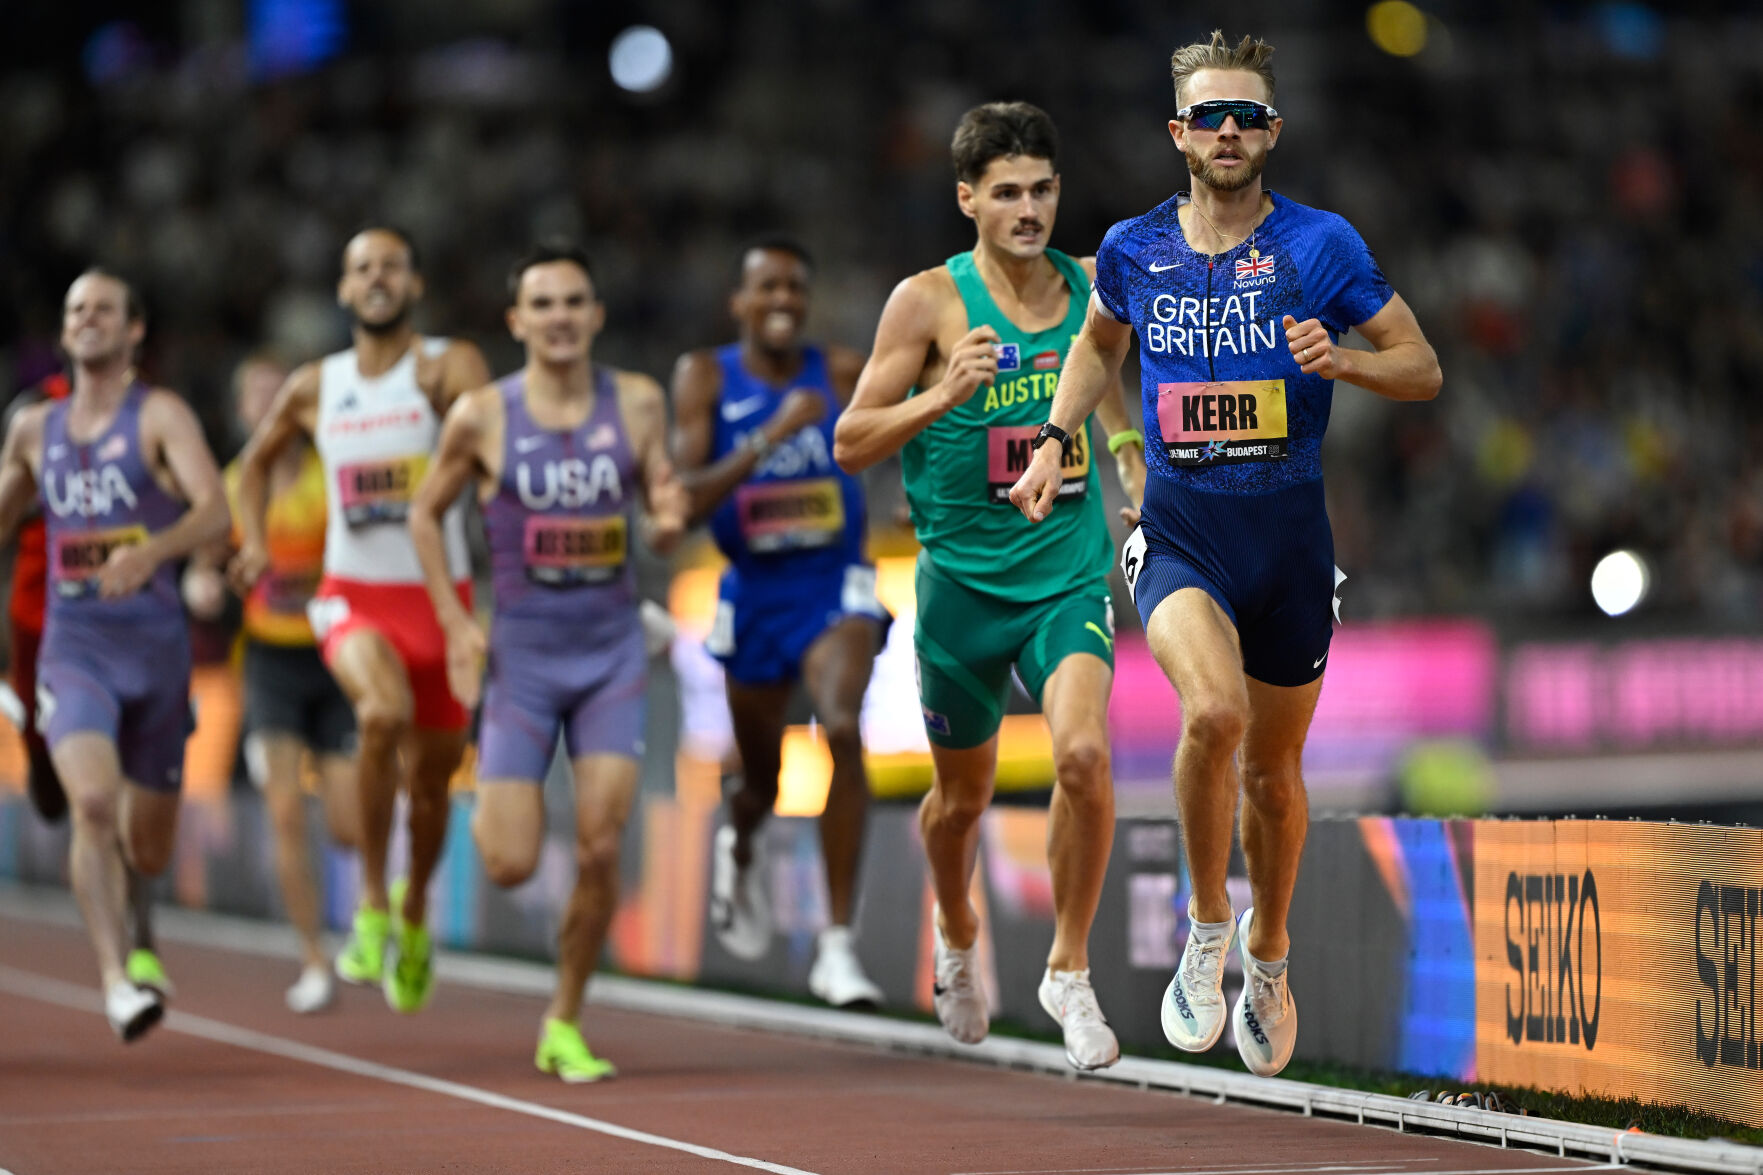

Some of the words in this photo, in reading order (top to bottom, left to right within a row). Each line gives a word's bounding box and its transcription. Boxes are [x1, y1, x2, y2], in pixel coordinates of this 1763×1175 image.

[1233, 275, 1276, 290] Novuna
[1153, 291, 1262, 327] GREAT
[1148, 319, 1276, 358] BRITAIN
[984, 373, 1058, 413] AUSTR
[1182, 394, 1258, 432] KERR
[1007, 433, 1085, 473] MRS
[1227, 445, 1268, 457] BUDAPEST
[44, 463, 138, 518] USA
[516, 454, 623, 511] USA
[1505, 867, 1601, 1051] SEIKO
[1695, 880, 1763, 1070] SEI
